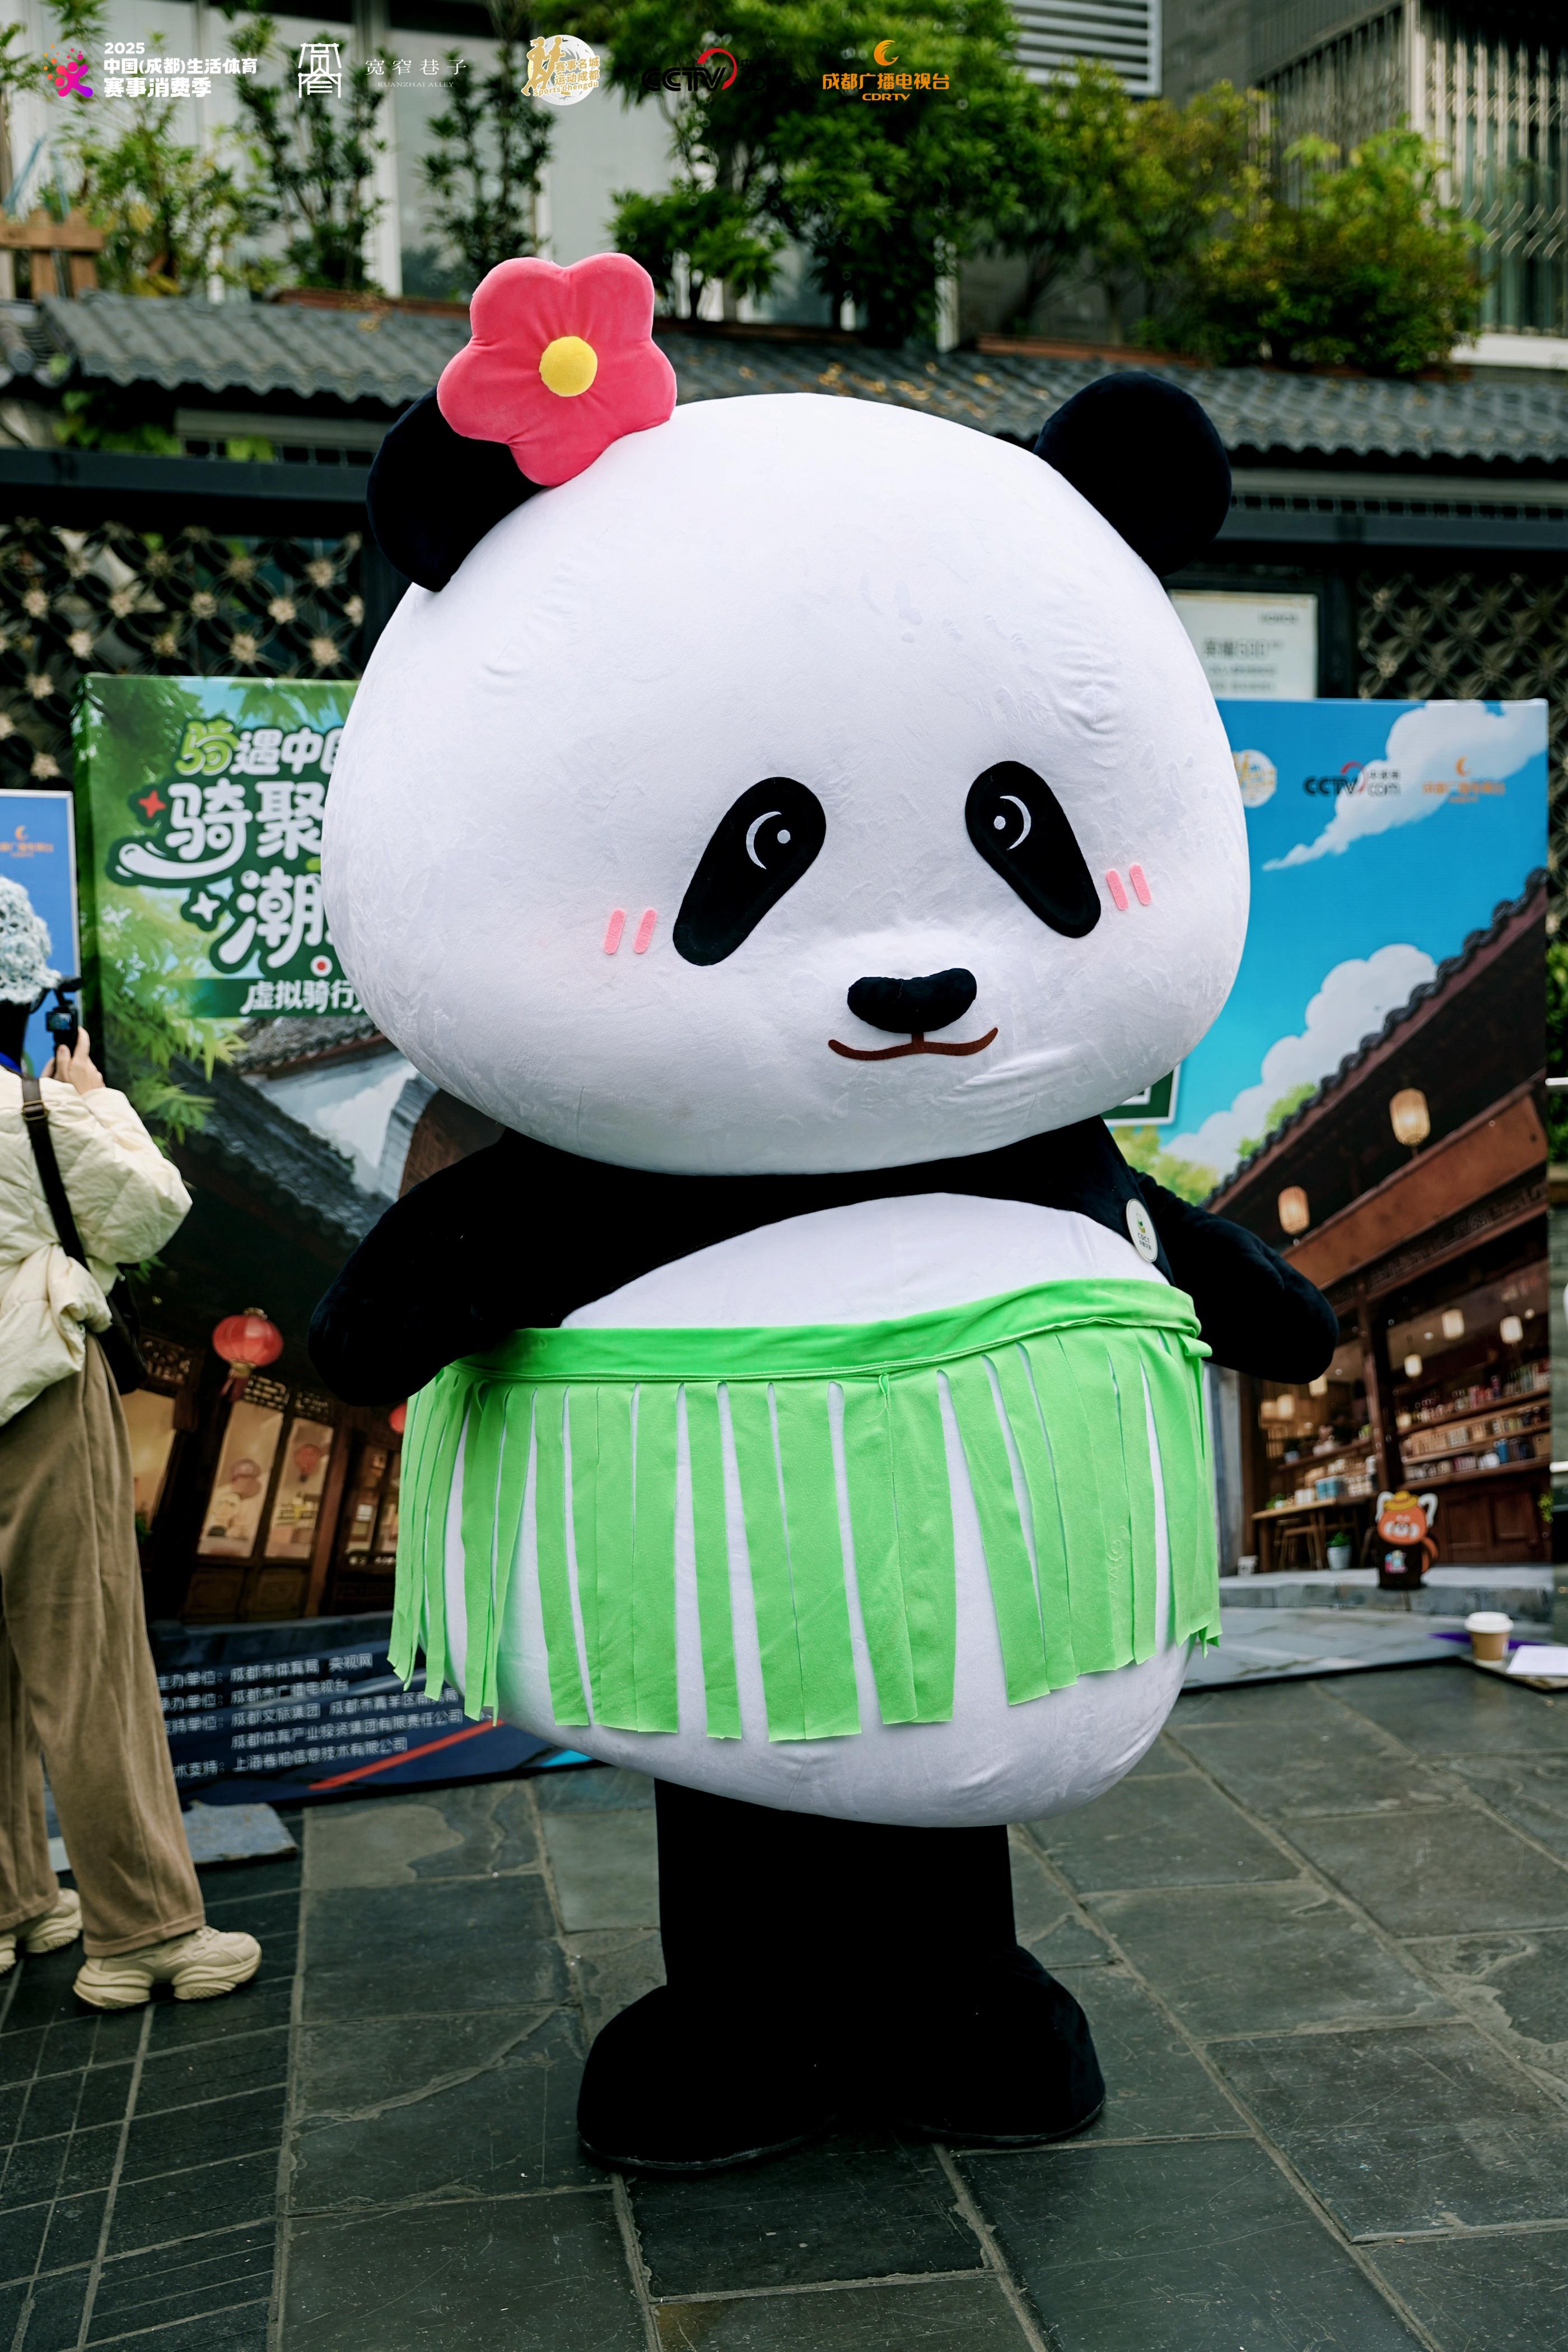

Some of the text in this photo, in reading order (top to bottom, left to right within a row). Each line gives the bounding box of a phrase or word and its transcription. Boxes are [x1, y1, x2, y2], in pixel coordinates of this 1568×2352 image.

[1303, 775, 1357, 796] CCTV
[218, 866, 334, 968] 潮
[240, 979, 363, 1015] 虚拟骑行
[230, 1658, 320, 1683] 成都市体育局
[328, 1653, 373, 1673] 央视网
[231, 1678, 349, 1705] 成都市广播电视台
[231, 1702, 321, 1728] 成都文旅集团
